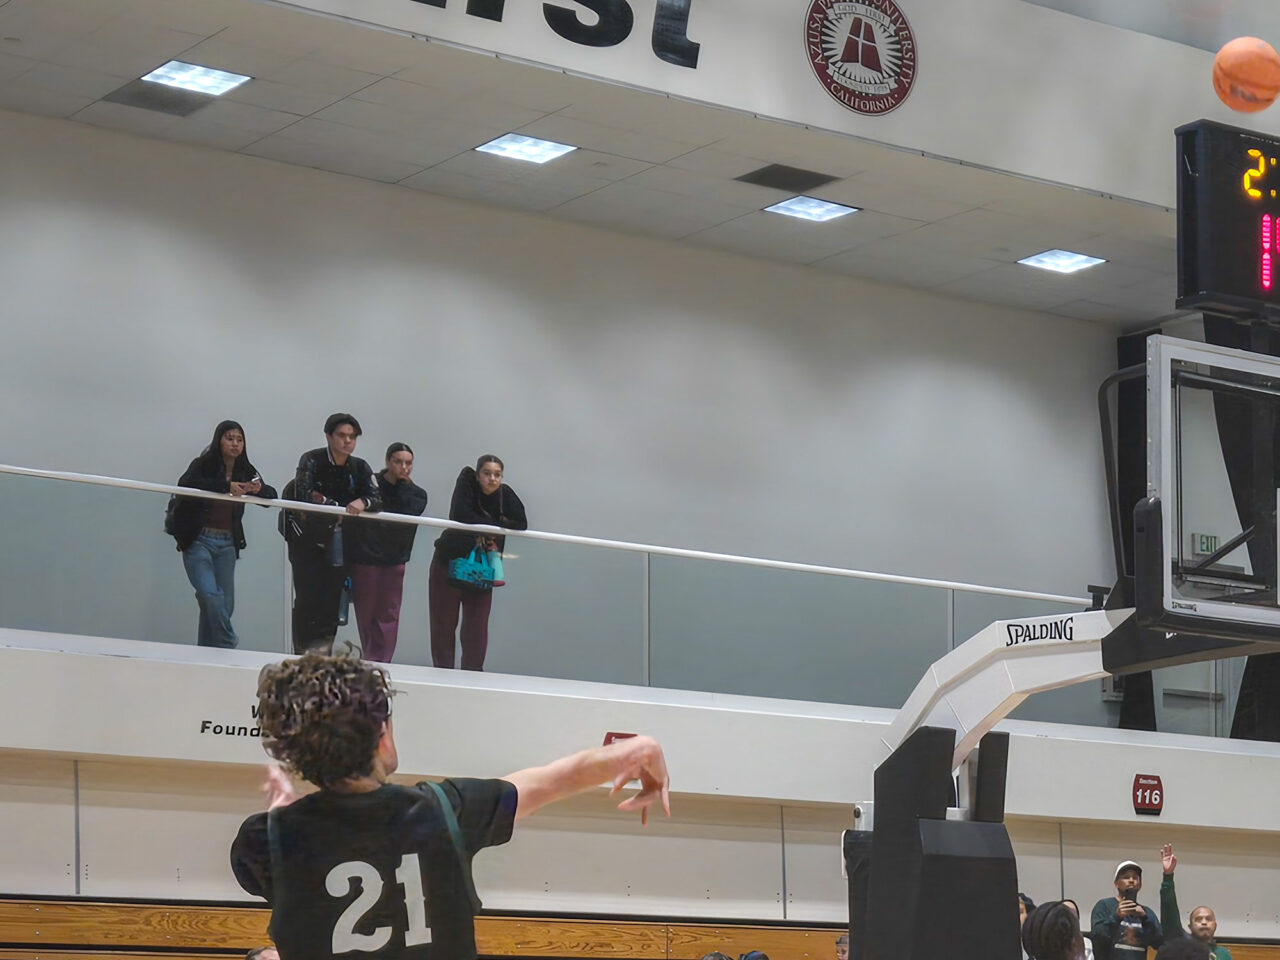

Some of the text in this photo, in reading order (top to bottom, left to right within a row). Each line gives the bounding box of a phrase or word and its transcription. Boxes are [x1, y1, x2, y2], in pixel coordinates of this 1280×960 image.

[809, 12, 826, 64] AZUSA
[830, 83, 896, 112] CALIFORNIA
[1200, 534, 1217, 553] EXIT
[1006, 617, 1073, 646] SPALDING
[200, 720, 263, 738] Found
[1136, 788, 1161, 805] 116
[325, 853, 432, 954] 21
